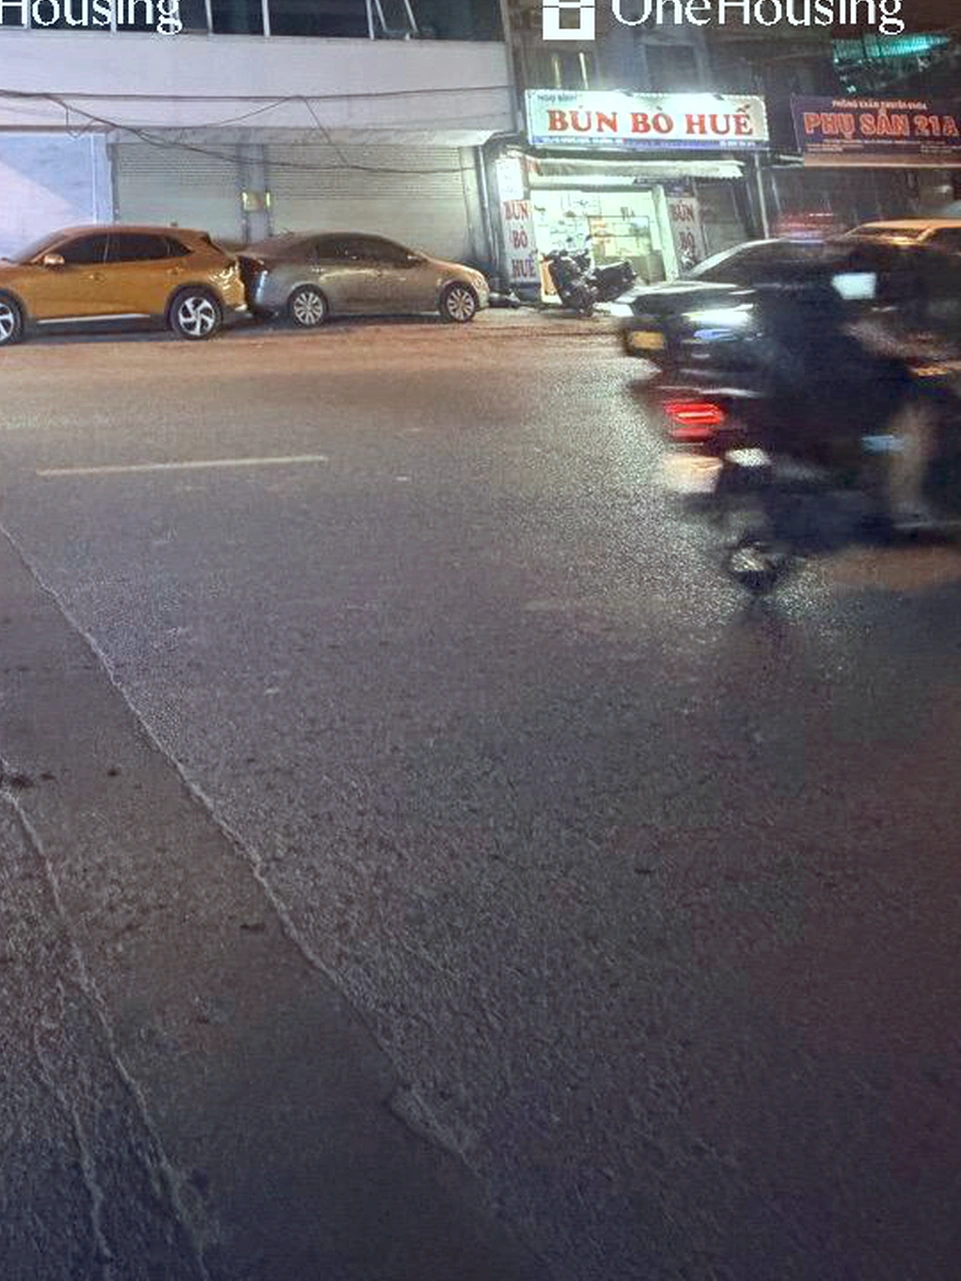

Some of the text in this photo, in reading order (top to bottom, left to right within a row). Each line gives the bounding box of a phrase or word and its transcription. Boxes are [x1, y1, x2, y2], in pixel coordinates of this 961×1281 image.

[546, 104, 754, 136] BÚN BÒ HUẾ
[804, 107, 960, 140] PHỤ SẢN 21A
